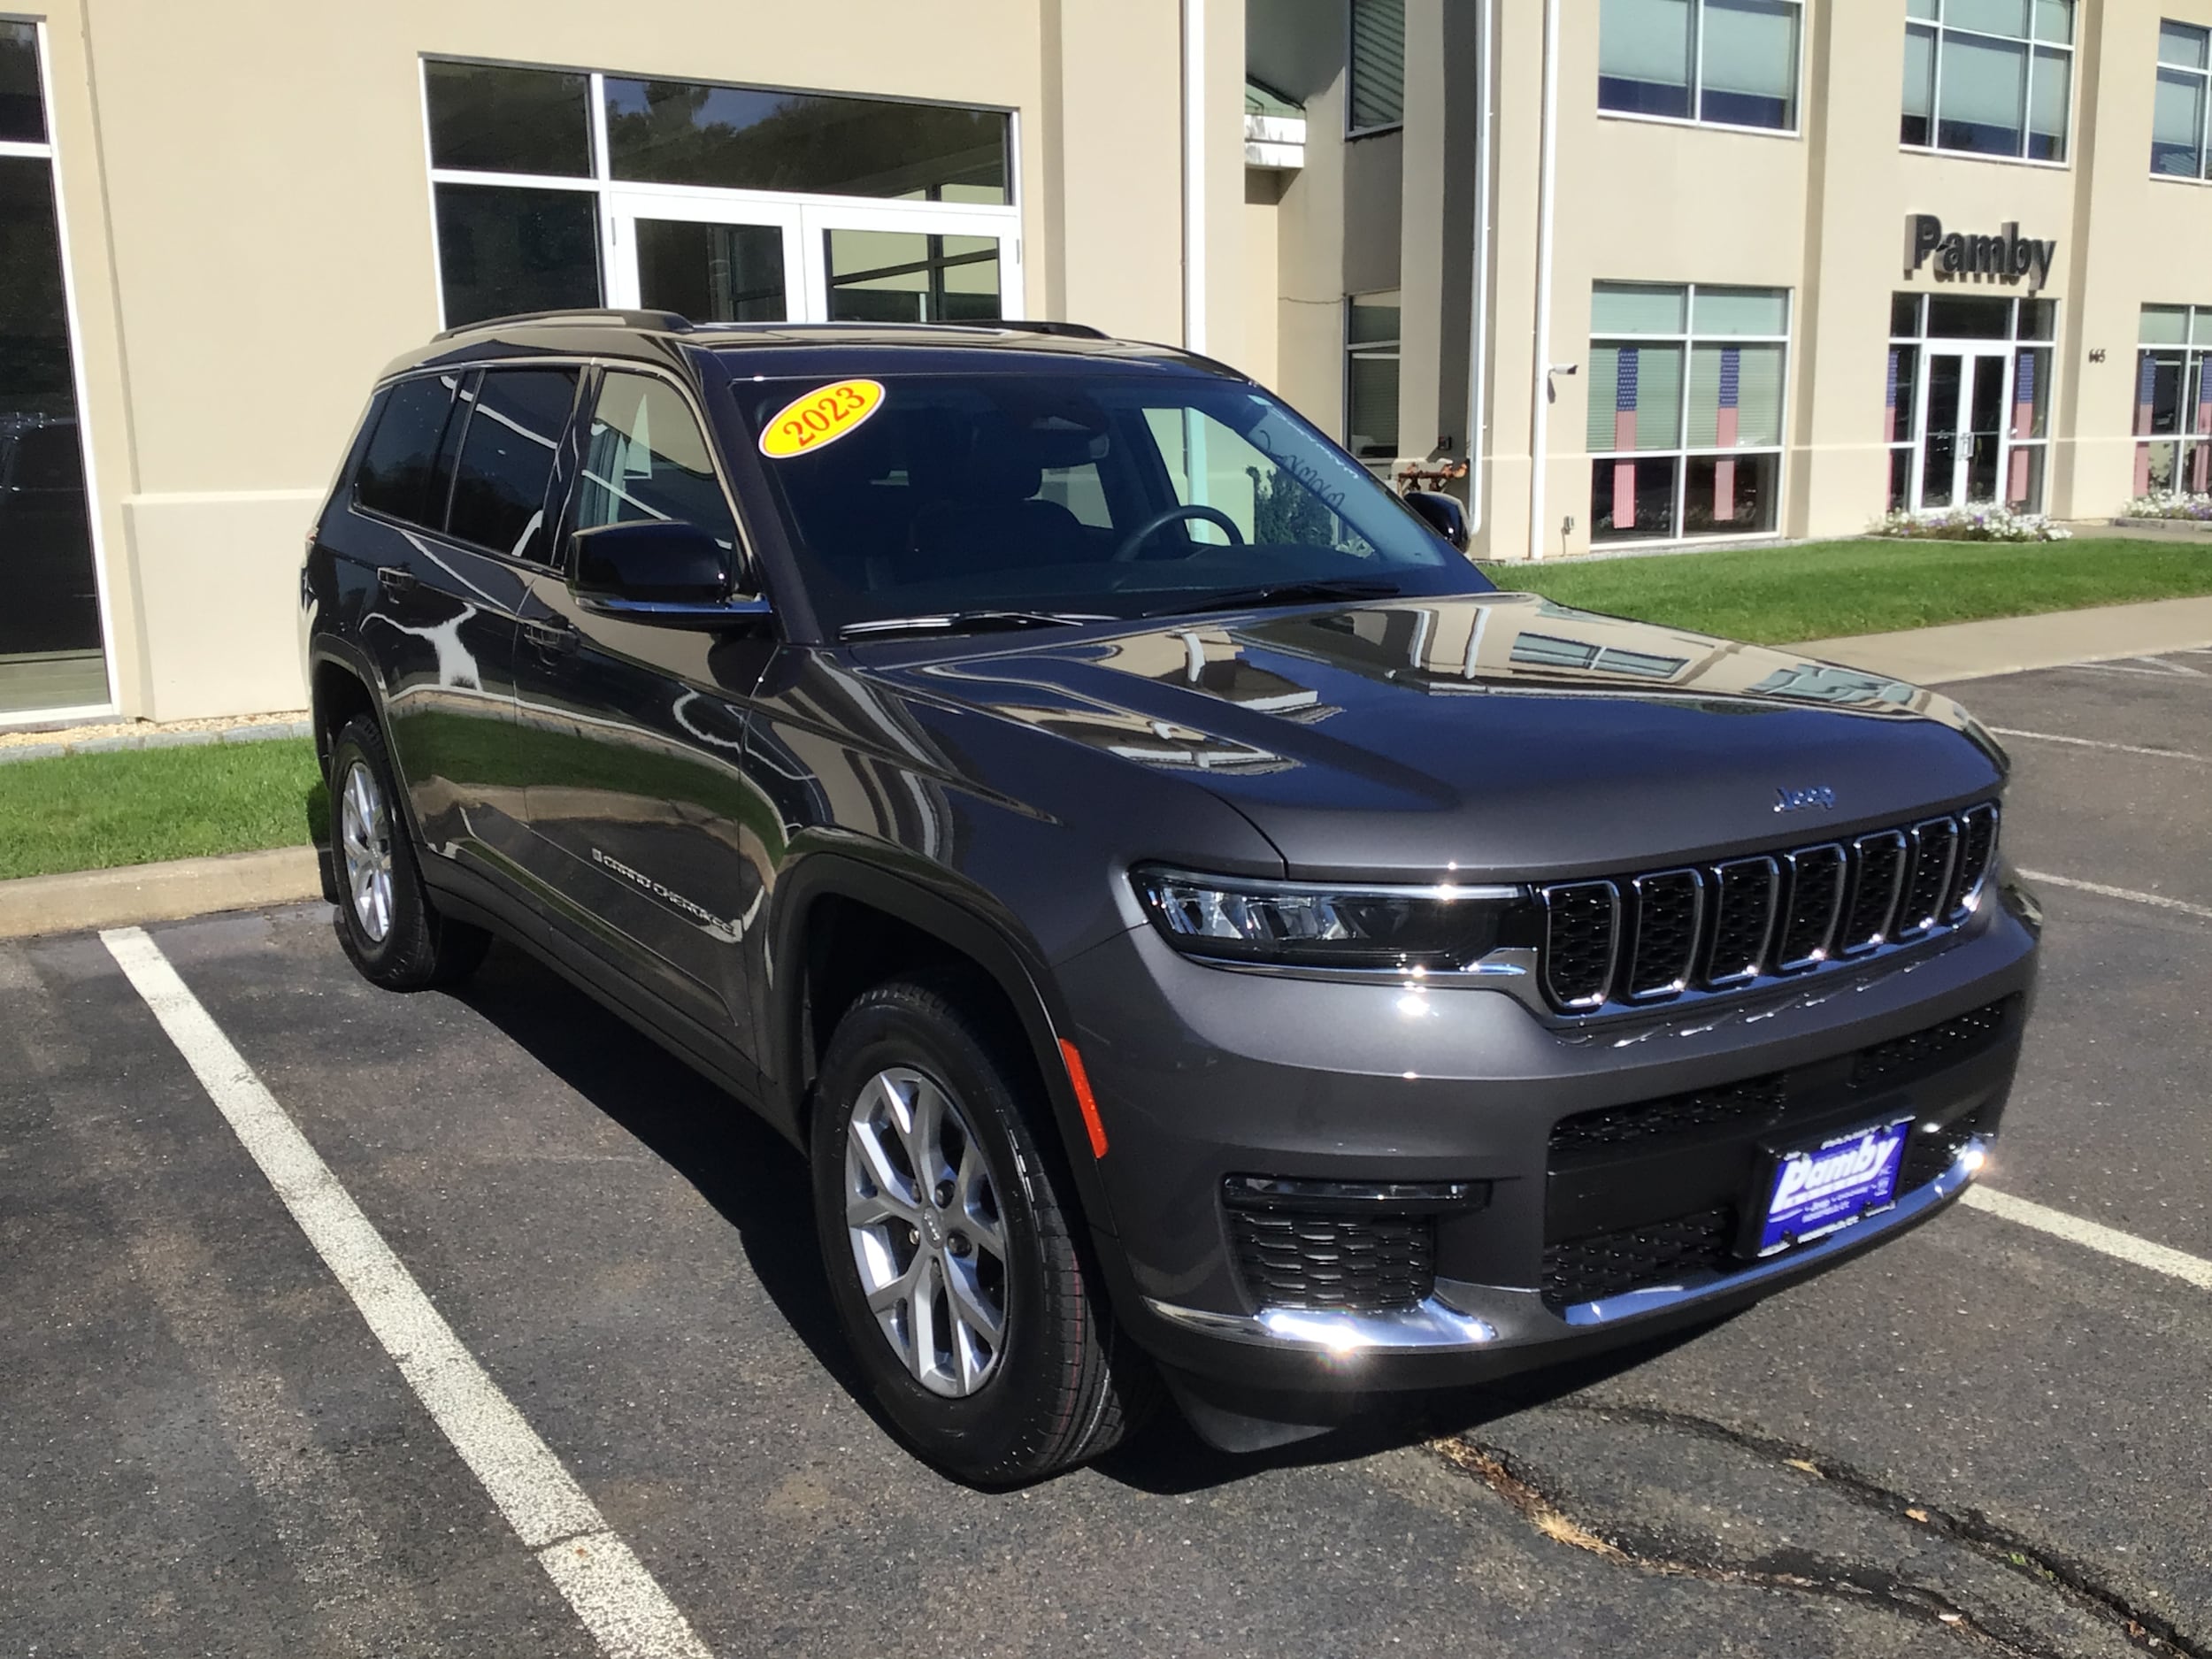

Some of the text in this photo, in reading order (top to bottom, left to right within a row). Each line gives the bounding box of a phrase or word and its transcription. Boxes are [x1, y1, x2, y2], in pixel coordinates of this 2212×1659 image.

[1904, 213, 2057, 291] Pamby
[783, 387, 865, 447] 2023
[1770, 1134, 1901, 1215] Pamby
